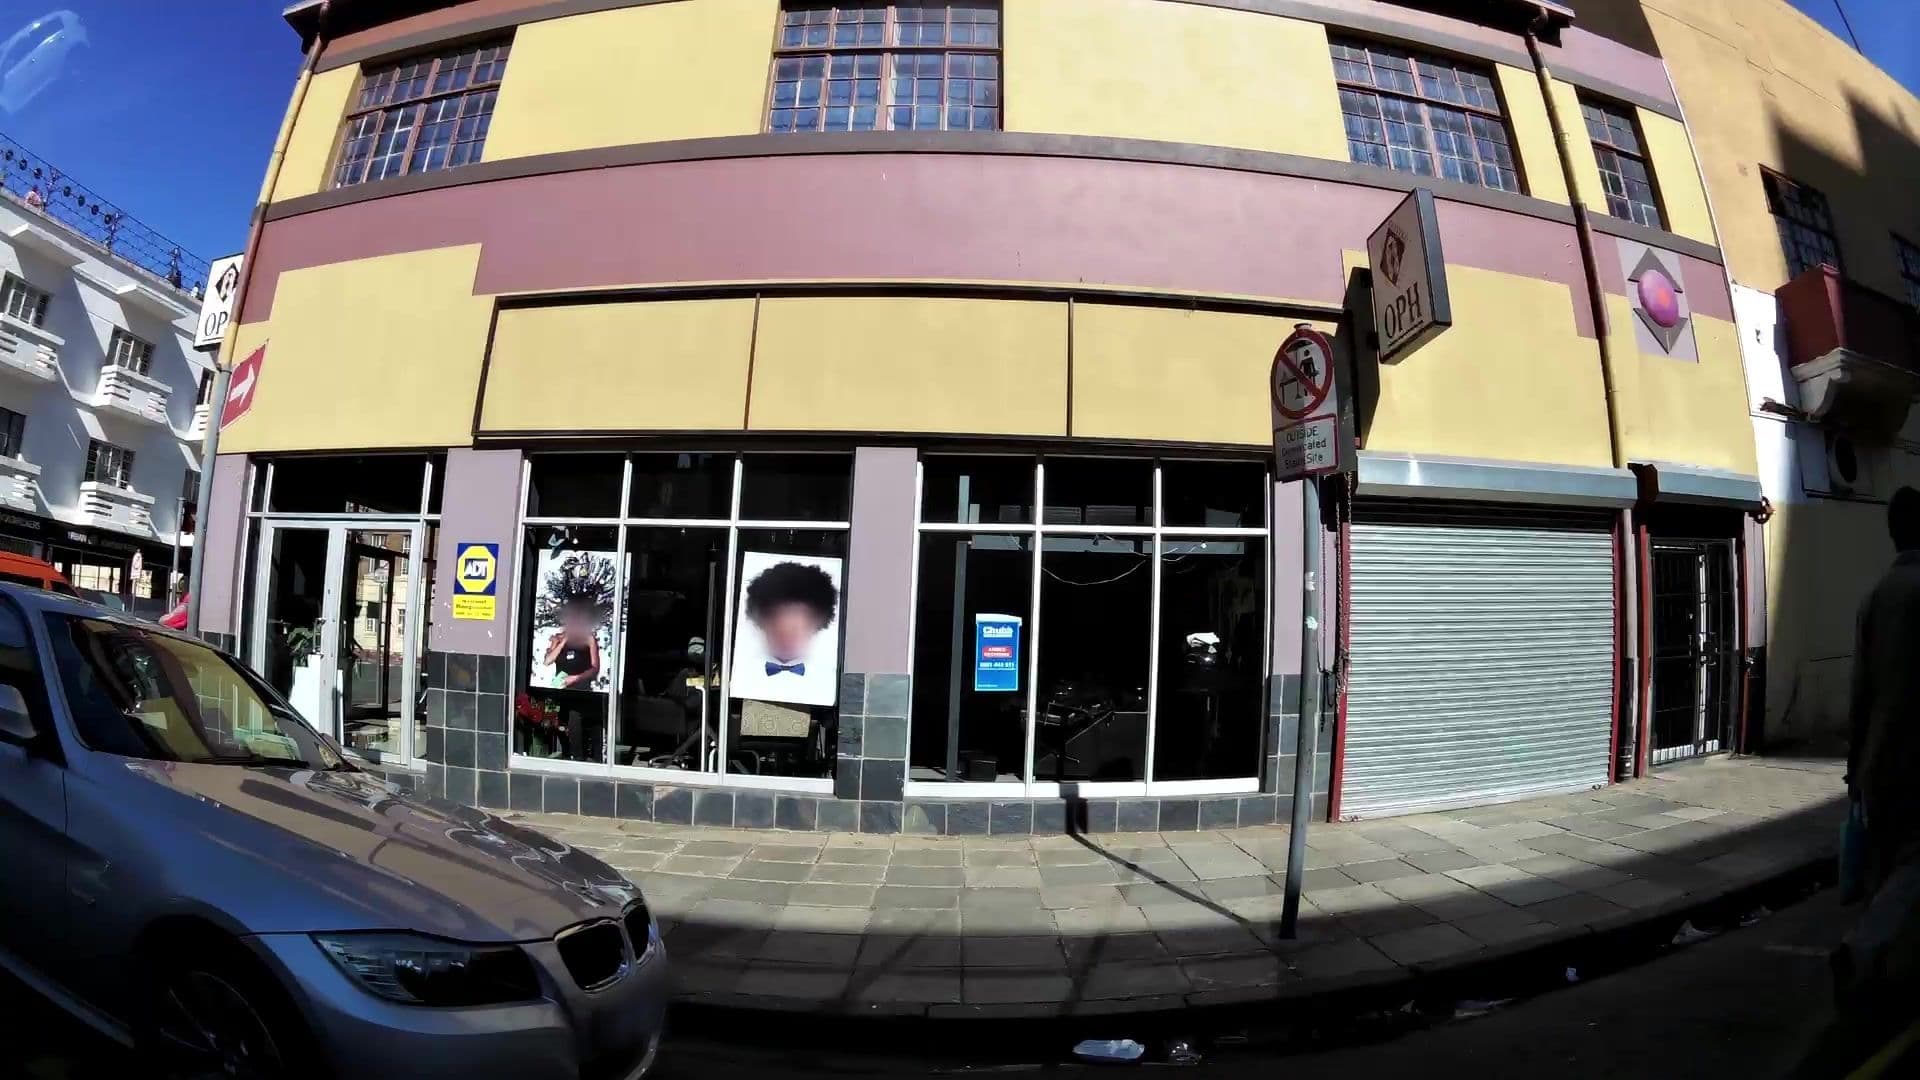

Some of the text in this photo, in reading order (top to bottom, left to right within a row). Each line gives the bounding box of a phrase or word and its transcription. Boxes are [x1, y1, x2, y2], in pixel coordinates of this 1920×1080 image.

[1384, 282, 1423, 339] OPH
[204, 310, 229, 337] OP
[1286, 425, 1319, 443] OUTSIDE
[465, 560, 488, 577] ADT
